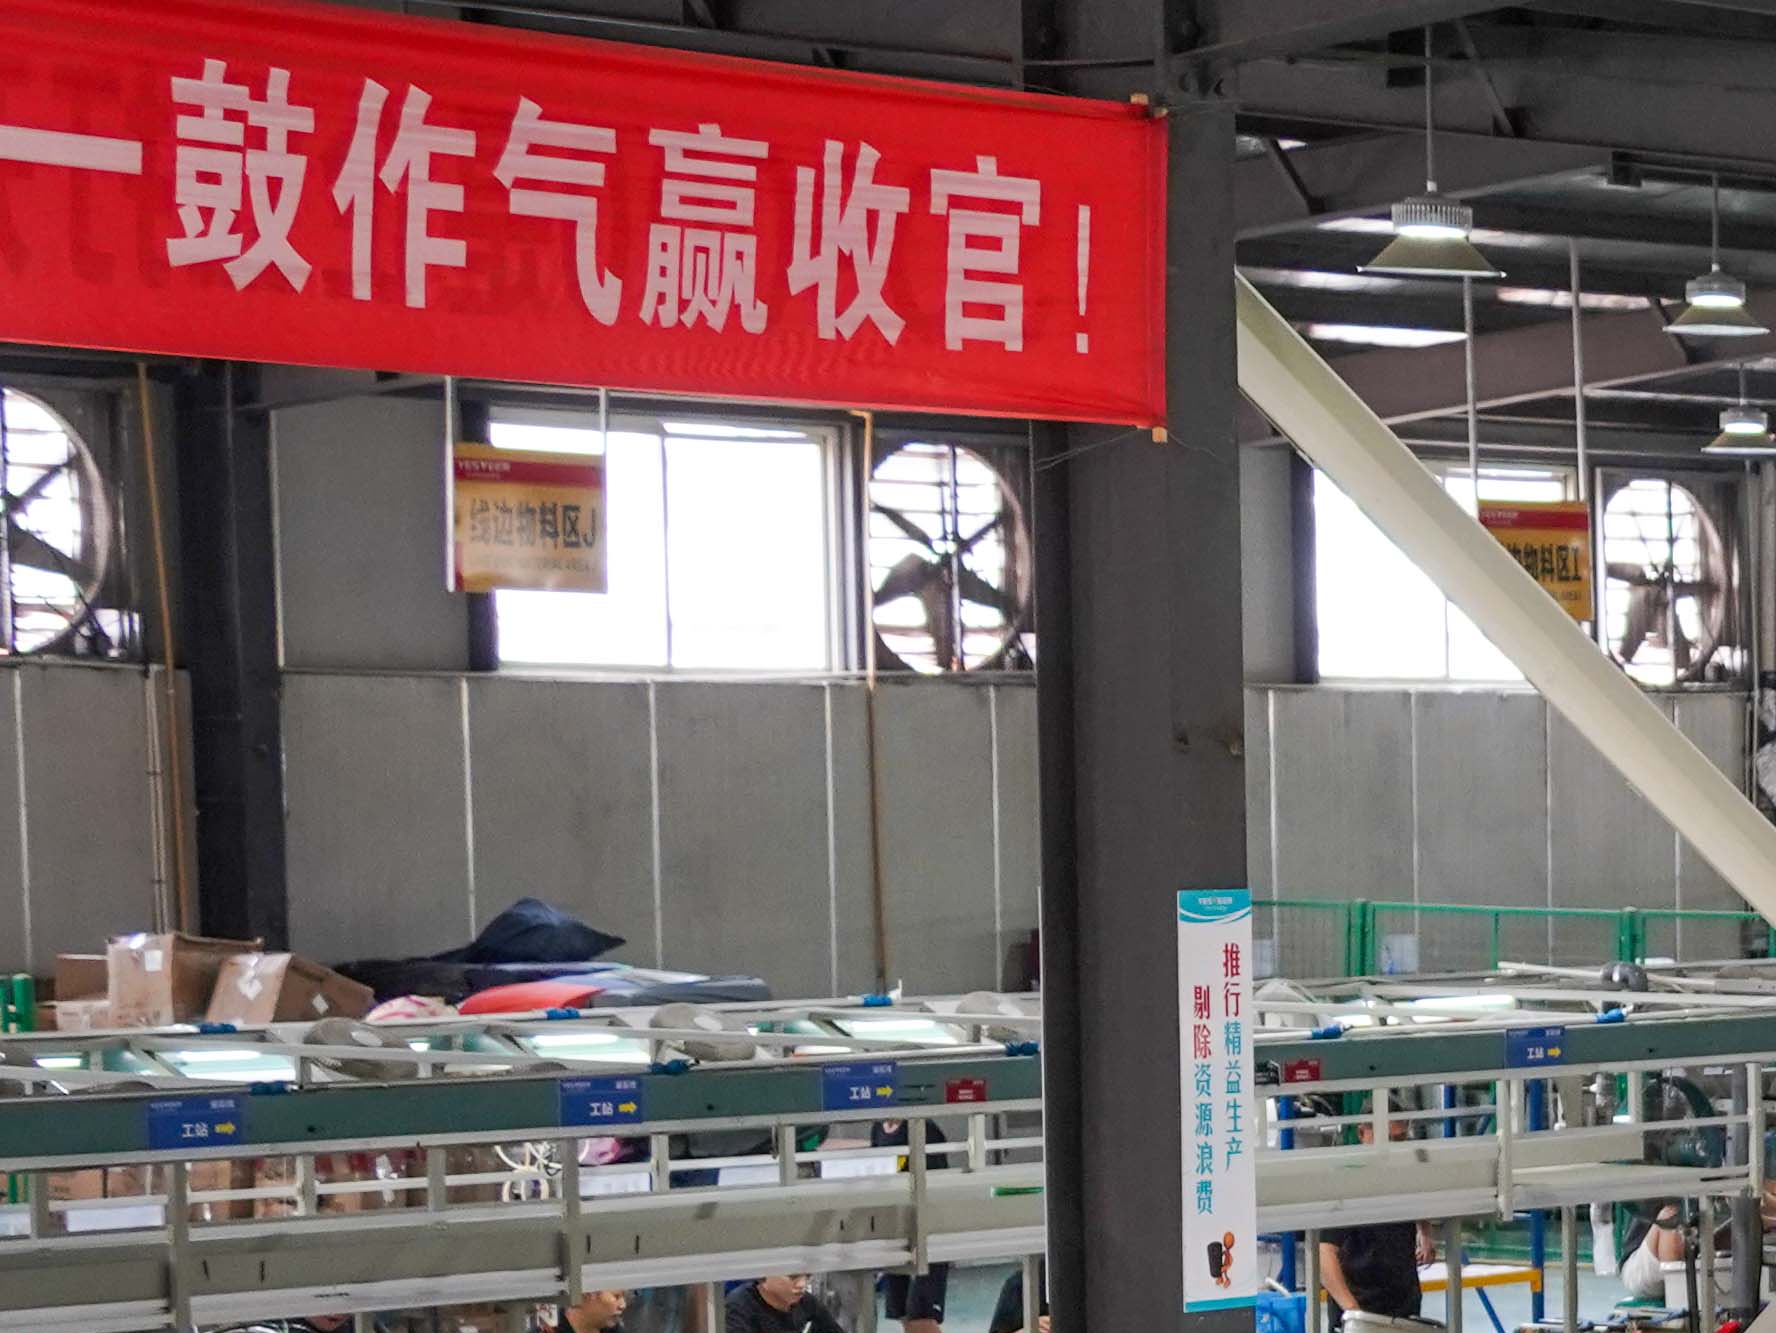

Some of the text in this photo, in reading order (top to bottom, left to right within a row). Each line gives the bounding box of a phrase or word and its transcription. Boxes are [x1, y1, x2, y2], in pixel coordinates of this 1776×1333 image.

[0, 57, 1092, 356] 一鼓作气赢收官！
[1193, 984, 1214, 1215] 剔除资源浪费
[1222, 942, 1243, 1172] 推行精益生产
